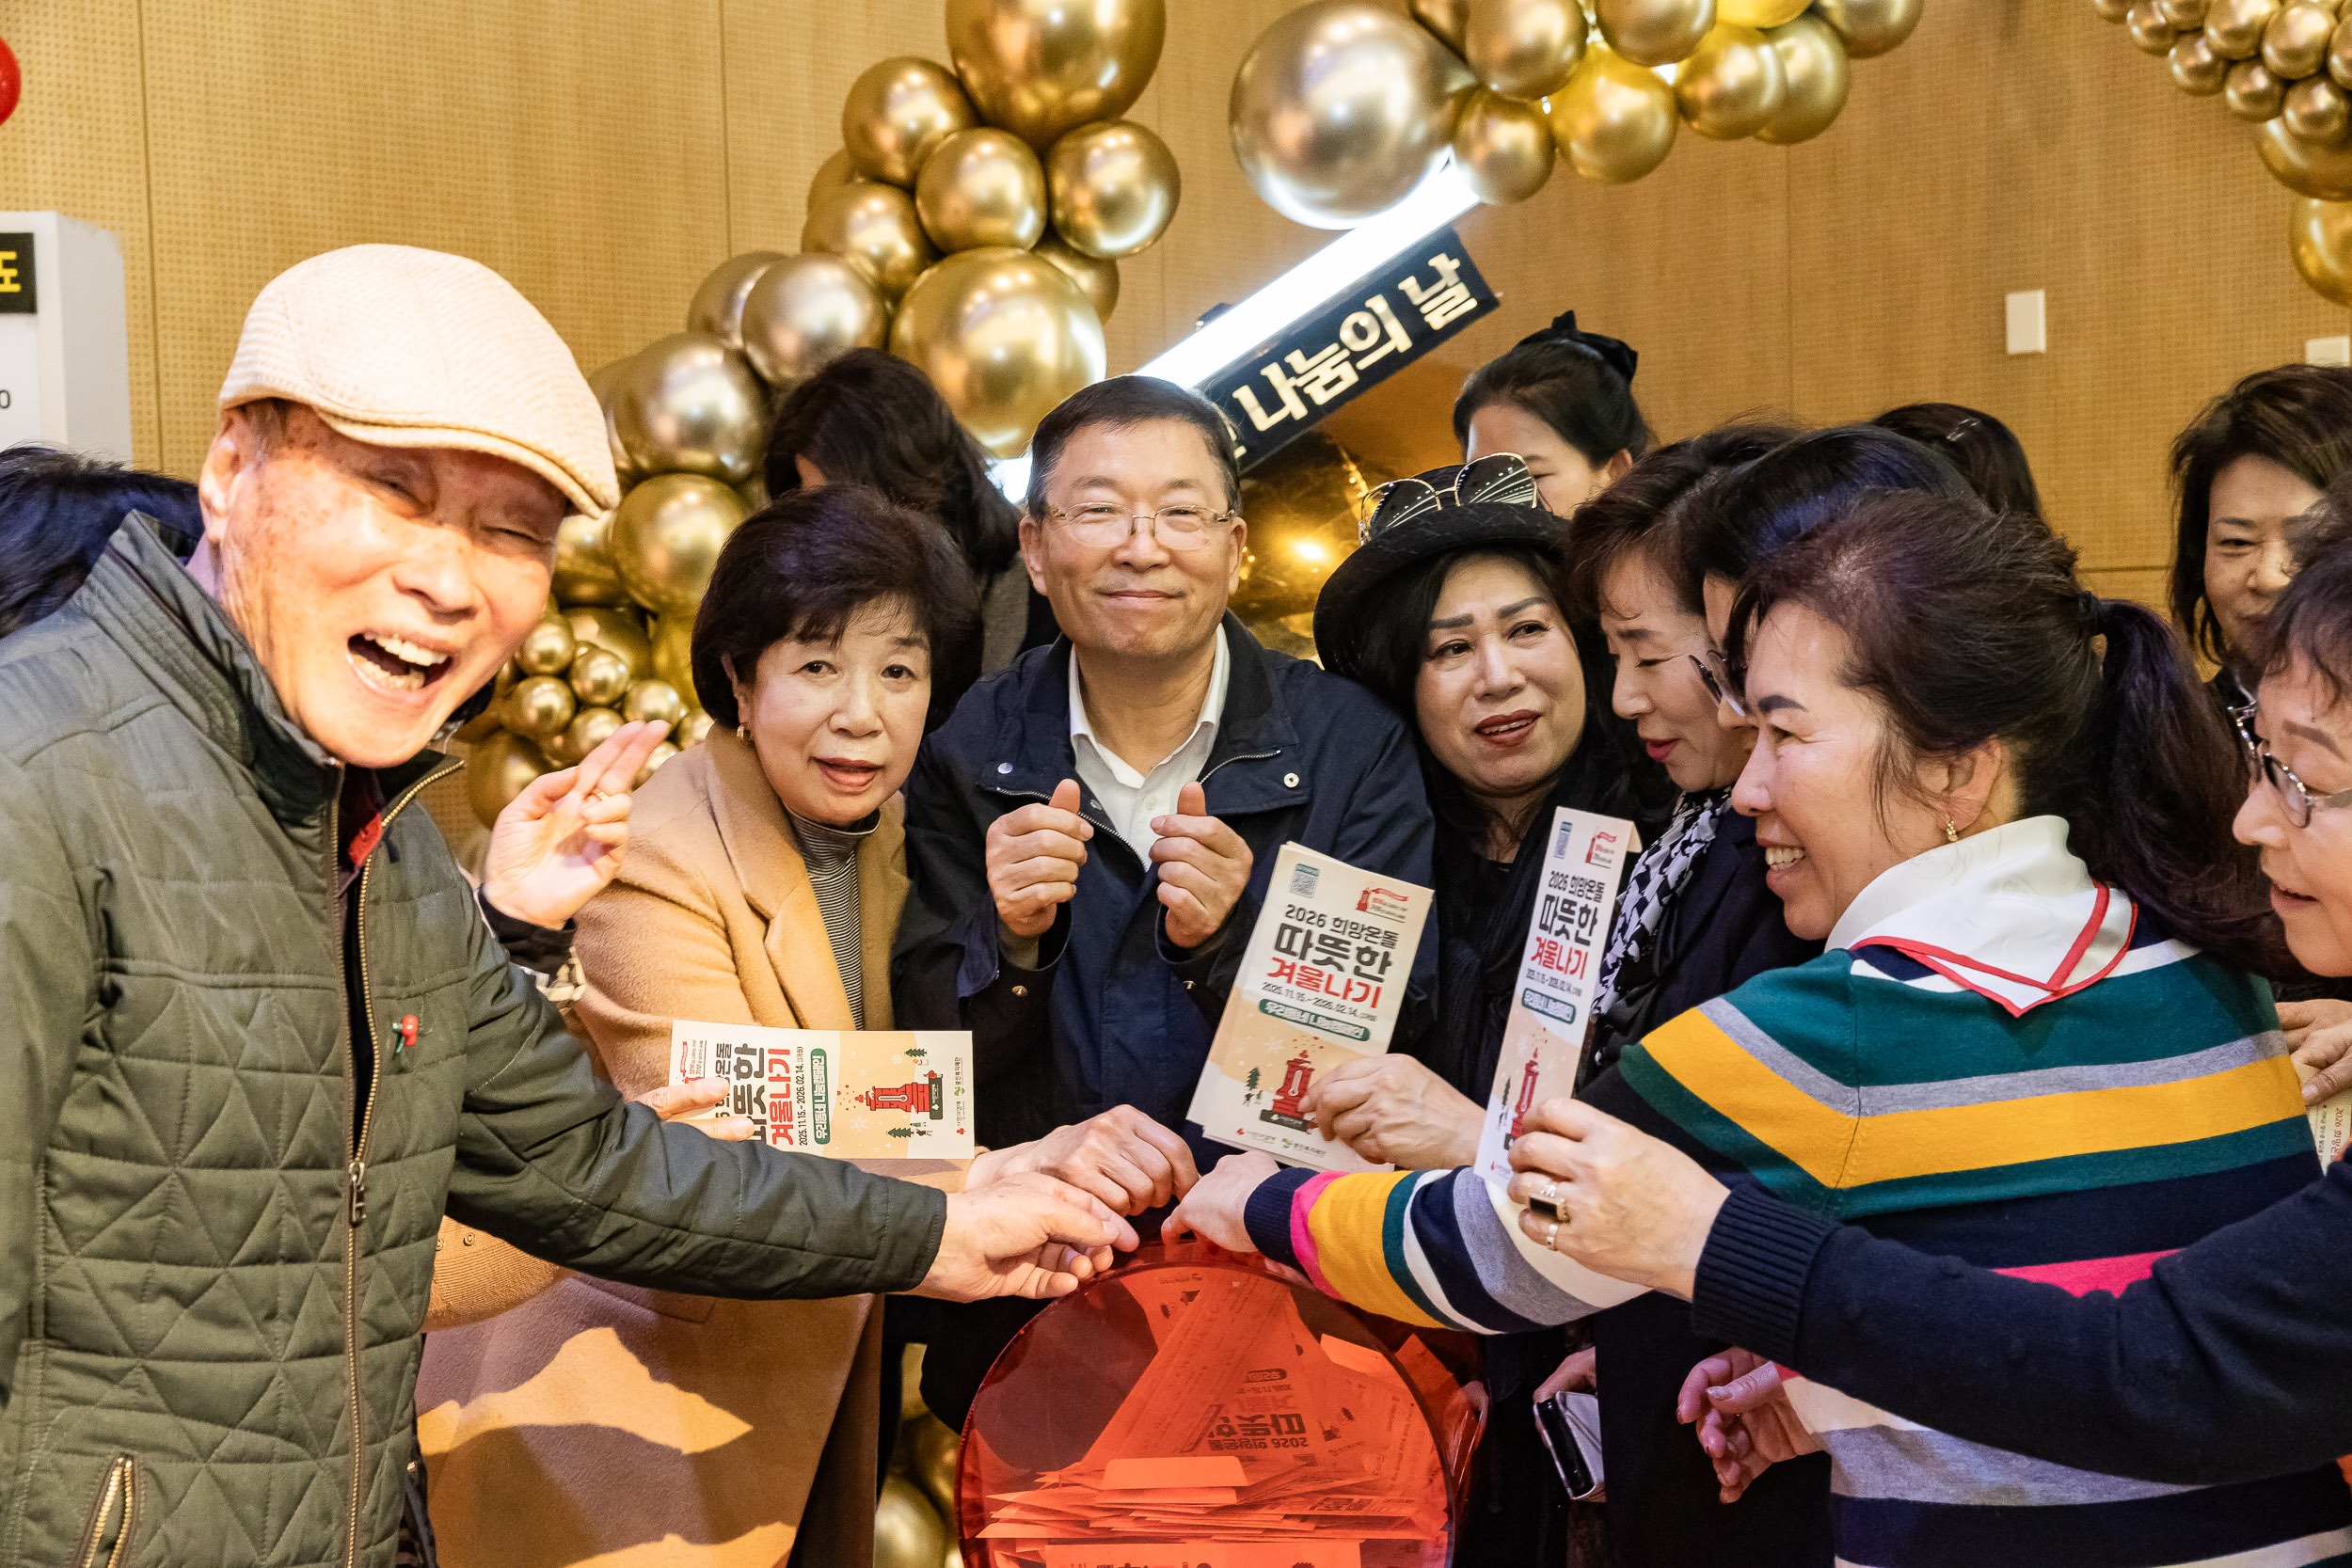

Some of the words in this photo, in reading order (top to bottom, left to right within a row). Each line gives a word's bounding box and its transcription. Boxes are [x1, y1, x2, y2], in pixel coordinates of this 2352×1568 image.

[1232, 293, 1412, 432] 나눔의
[1398, 252, 1478, 330] 날
[1285, 903, 1327, 928] 2026
[1328, 916, 1400, 950] 희망온돌
[1538, 894, 1598, 947] 따뜻한
[1273, 922, 1393, 984] 따뜻한
[1530, 936, 1589, 980] 겨울나기
[1266, 956, 1383, 1009] 겨울나기
[767, 1048, 794, 1146] 겨울나기
[811, 1054, 827, 1103] 나눔캠페인
[814, 1103, 828, 1139] 우리동네
[2334, 1107, 2344, 1128] 2026
[1270, 1437, 1310, 1449] 2026
